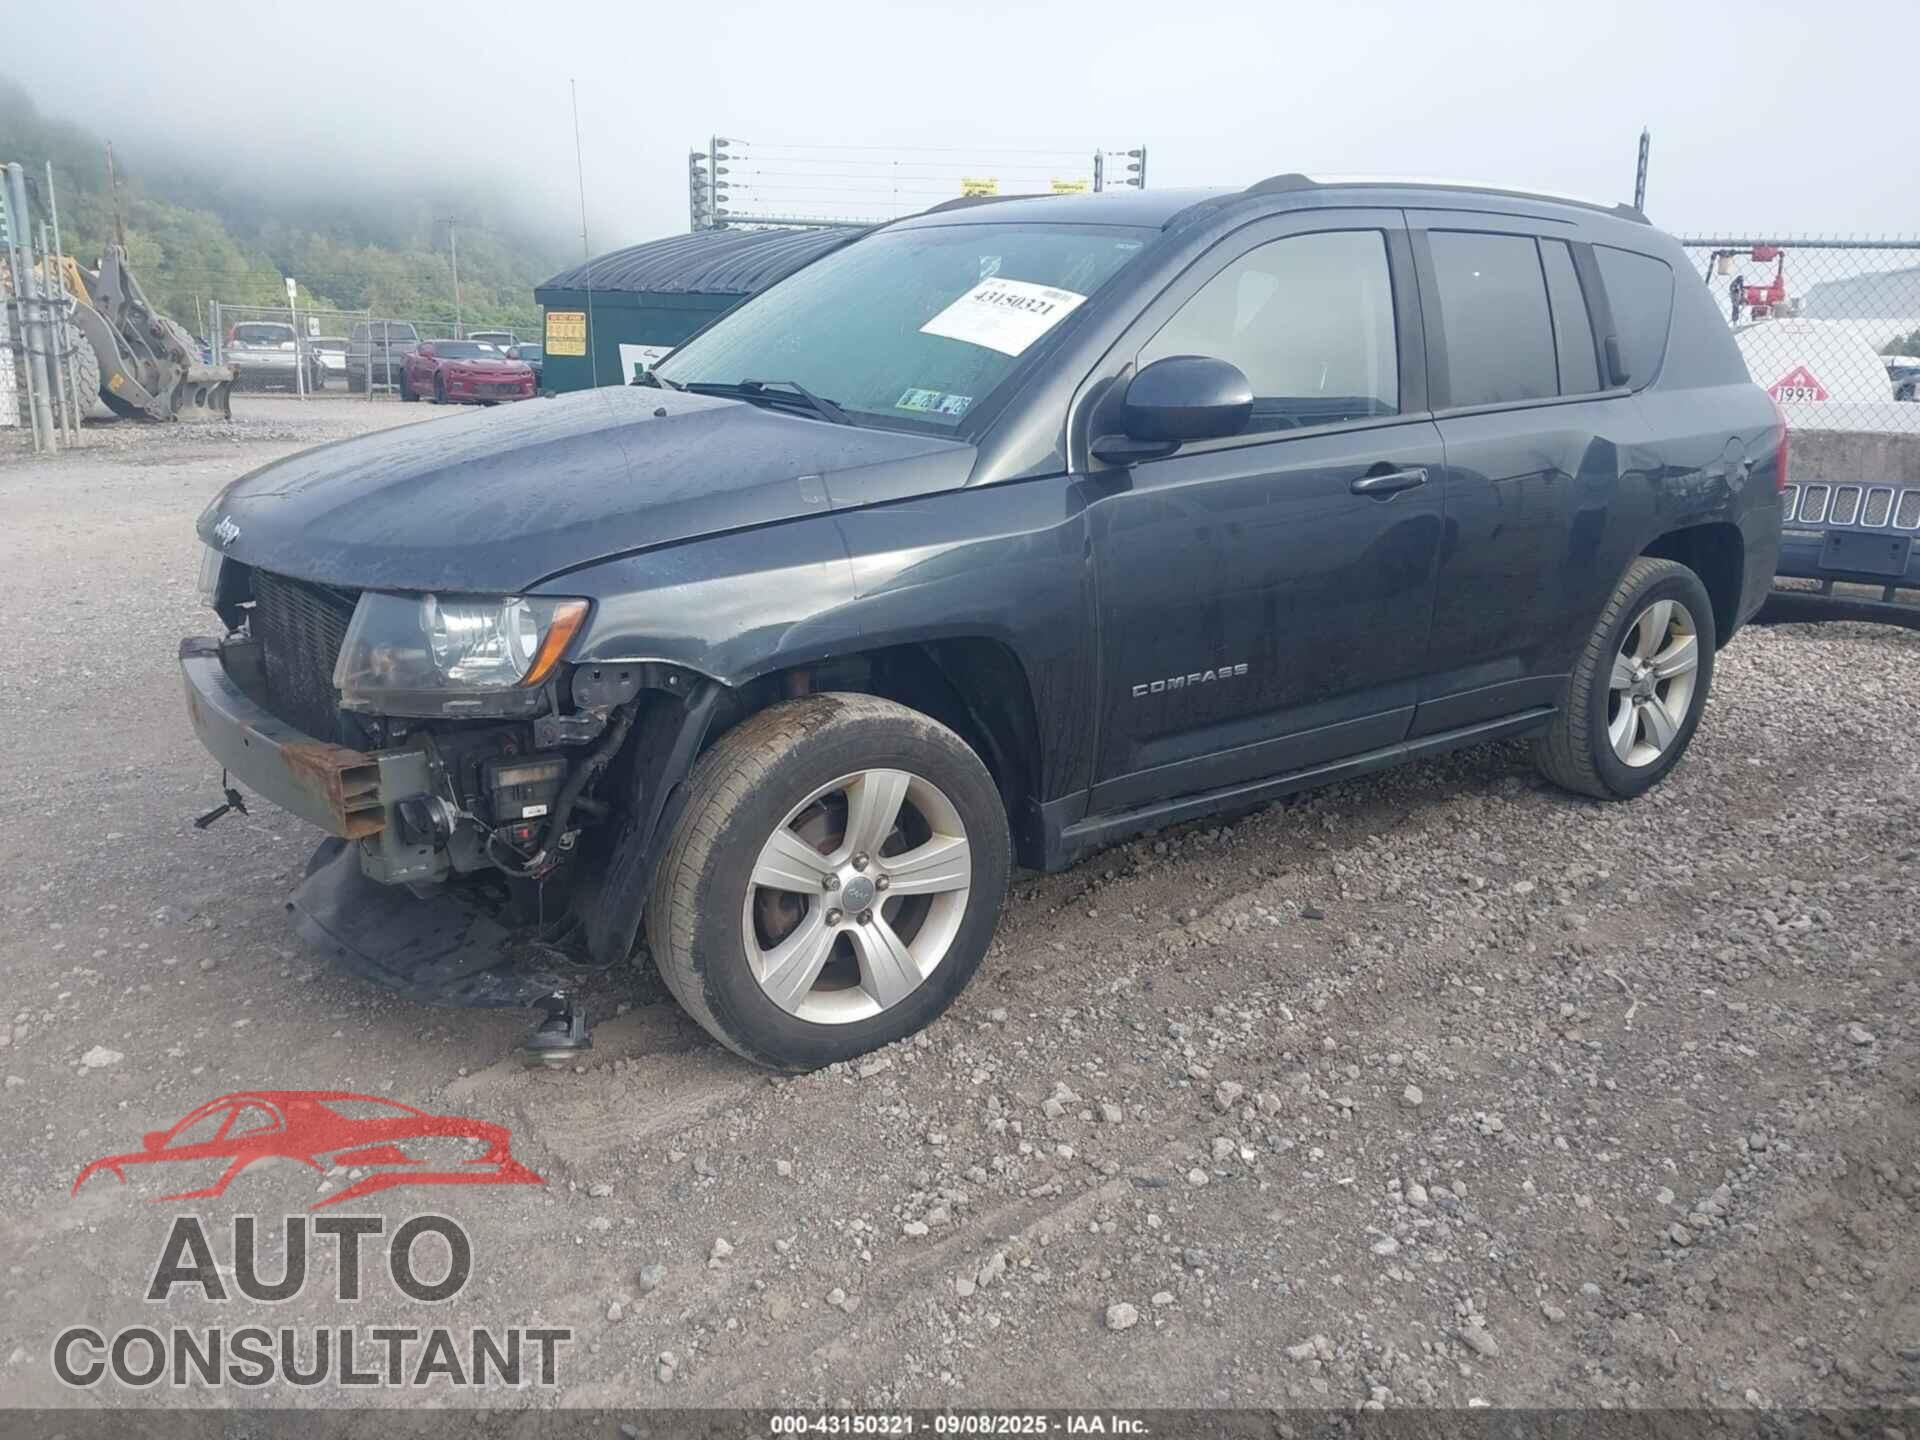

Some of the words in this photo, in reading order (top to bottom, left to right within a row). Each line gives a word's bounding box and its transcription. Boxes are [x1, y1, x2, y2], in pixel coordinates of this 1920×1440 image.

[974, 290, 1056, 316] 43150321
[1779, 387, 1814, 401] 1993
[1132, 663, 1248, 697] COMPASS
